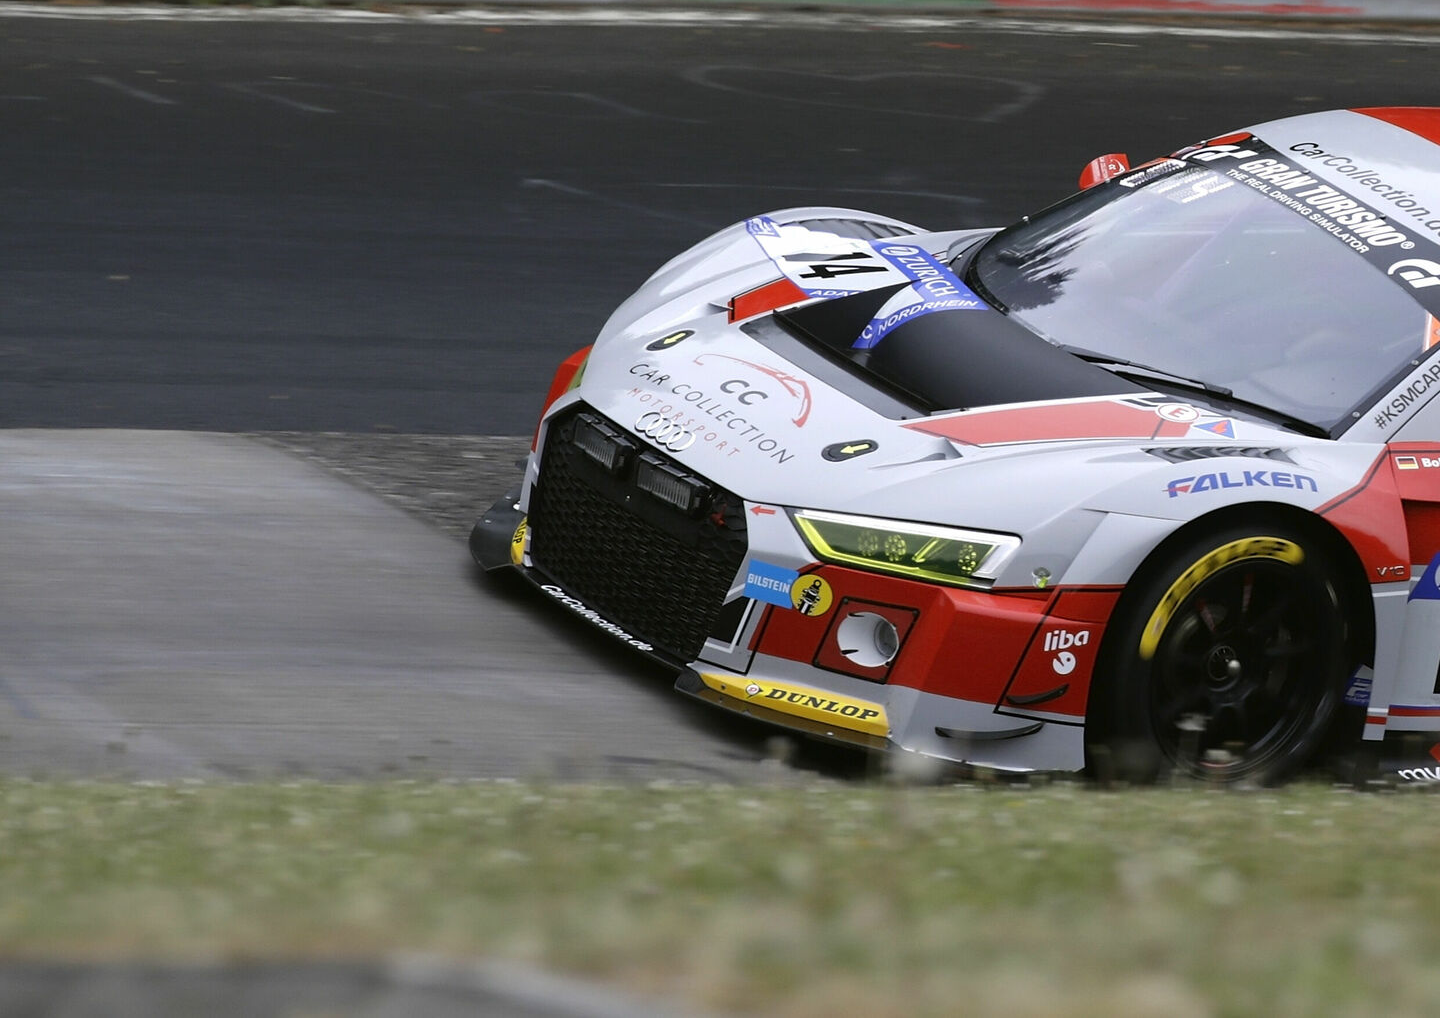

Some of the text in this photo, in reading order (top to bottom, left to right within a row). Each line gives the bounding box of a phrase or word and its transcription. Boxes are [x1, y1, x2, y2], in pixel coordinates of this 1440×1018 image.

[1226, 169, 1246, 181] THE
[1244, 177, 1272, 194] REAL
[1269, 190, 1312, 216] DRIVING
[1308, 212, 1370, 254] SIMULATOR
[1238, 158, 1318, 191] GRAN
[1294, 185, 1408, 247] TURISMO
[782, 252, 890, 279] 14
[896, 256, 961, 298] ZURICH
[877, 300, 979, 336] NORDRHEIN
[720, 379, 768, 406] CC
[628, 387, 741, 457] MOTORSPORT
[629, 363, 795, 464] CAR COLLECTION
[1162, 470, 1318, 498] FALKEN
[747, 573, 791, 594] BILSTEIN
[1044, 629, 1090, 652] liba
[765, 688, 880, 720] DUNLOP
